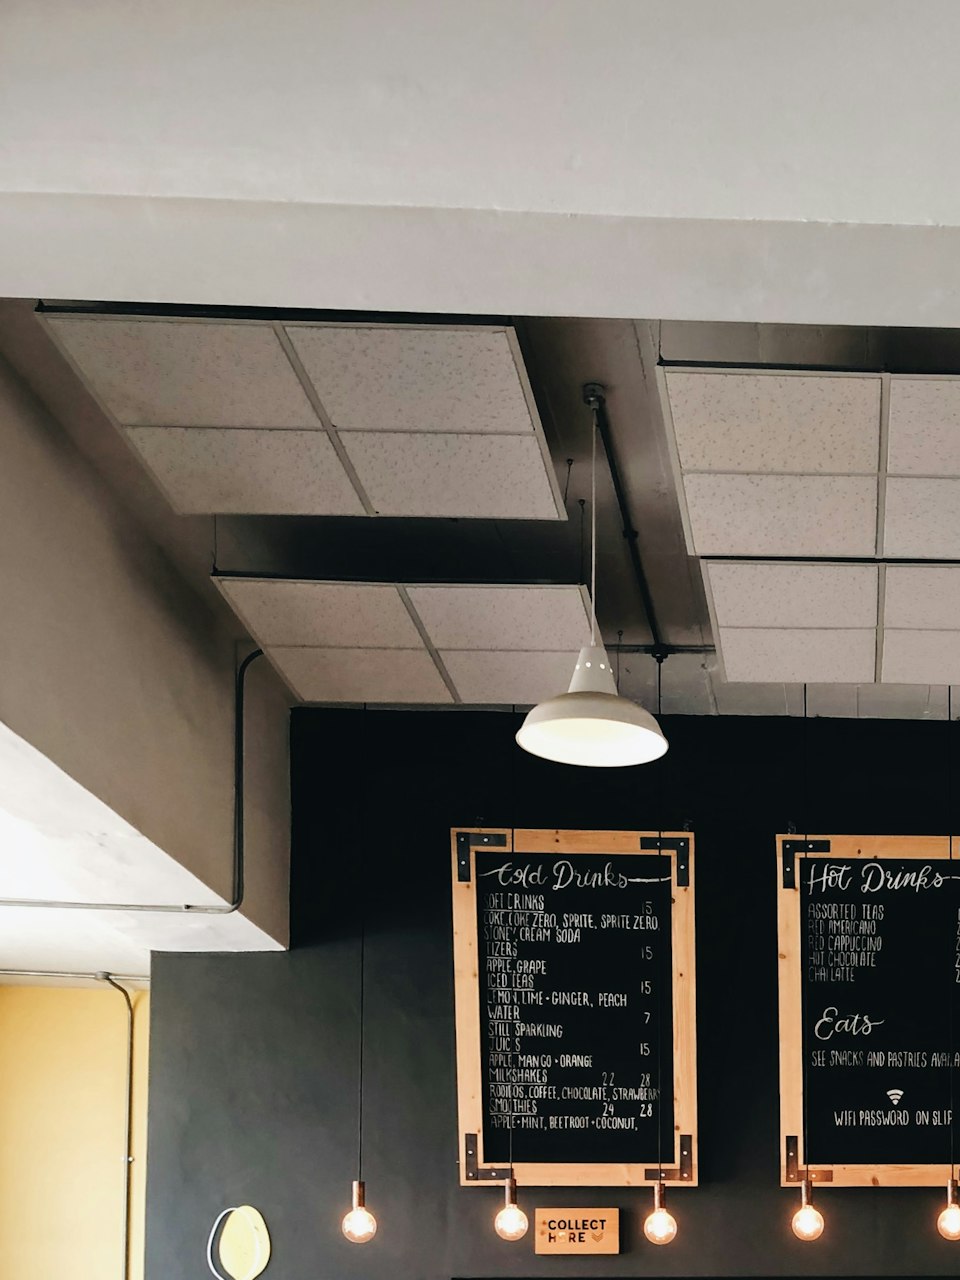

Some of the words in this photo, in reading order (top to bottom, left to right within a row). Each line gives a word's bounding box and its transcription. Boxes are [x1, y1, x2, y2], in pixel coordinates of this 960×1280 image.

[498, 862, 548, 888] Cold
[552, 860, 629, 890] Drinks
[807, 863, 853, 896] Hot
[860, 862, 943, 893] Drinks
[484, 893, 504, 909] SOFT
[507, 893, 544, 910] DRINKS
[641, 901, 653, 915] 15
[808, 903, 857, 920] ASSORTED
[862, 904, 885, 920] TEAS
[532, 913, 559, 930] ZERO,
[562, 913, 597, 929] SPRITE,
[600, 914, 631, 930] SPRITE
[808, 919, 825, 935] RED
[828, 919, 876, 935] AMERICANO
[519, 926, 551, 942] CREAM
[556, 928, 581, 943] SODA
[808, 935, 825, 951] RED
[828, 935, 883, 951] CAPPUCCINO
[641, 946, 653, 960] 15
[828, 951, 877, 967] CHOCOLATE
[516, 960, 547, 975] GRAPE
[808, 966, 829, 982] CHAI
[830, 967, 855, 982] LATTE
[487, 973, 508, 988] ICED
[512, 973, 535, 988] TEAS
[640, 981, 652, 995] 15
[551, 991, 594, 1007] GINGER,
[598, 992, 628, 1007] PEACH
[487, 1005, 520, 1020] WATER
[643, 1012, 651, 1024] 7
[515, 1023, 563, 1038] SPARKLING
[814, 1006, 885, 1041] Eats
[488, 1036, 521, 1052] JUICS
[640, 1043, 650, 1056] 15
[518, 1054, 552, 1068] MANGO
[559, 1054, 593, 1068] ORANGE
[811, 1050, 826, 1067] SEE
[829, 1050, 864, 1067] SNACKS
[866, 1051, 886, 1068] AND
[887, 1051, 928, 1068] PASTRIES
[489, 1067, 548, 1083] MILKSHAKES
[601, 1071, 615, 1086] 22
[640, 1072, 651, 1088] 28
[528, 1085, 561, 1101] COFFEE,
[561, 1086, 610, 1102] CHOCOLATE,
[489, 1098, 538, 1113] SMOOTHIES
[602, 1102, 615, 1117] 24
[639, 1103, 653, 1117] 28
[834, 1110, 856, 1126] WIFI
[859, 1110, 910, 1126] PASSWORD
[915, 1110, 930, 1126] ON
[548, 1219, 606, 1230] COLLECT
[548, 1232, 586, 1243] HRE
